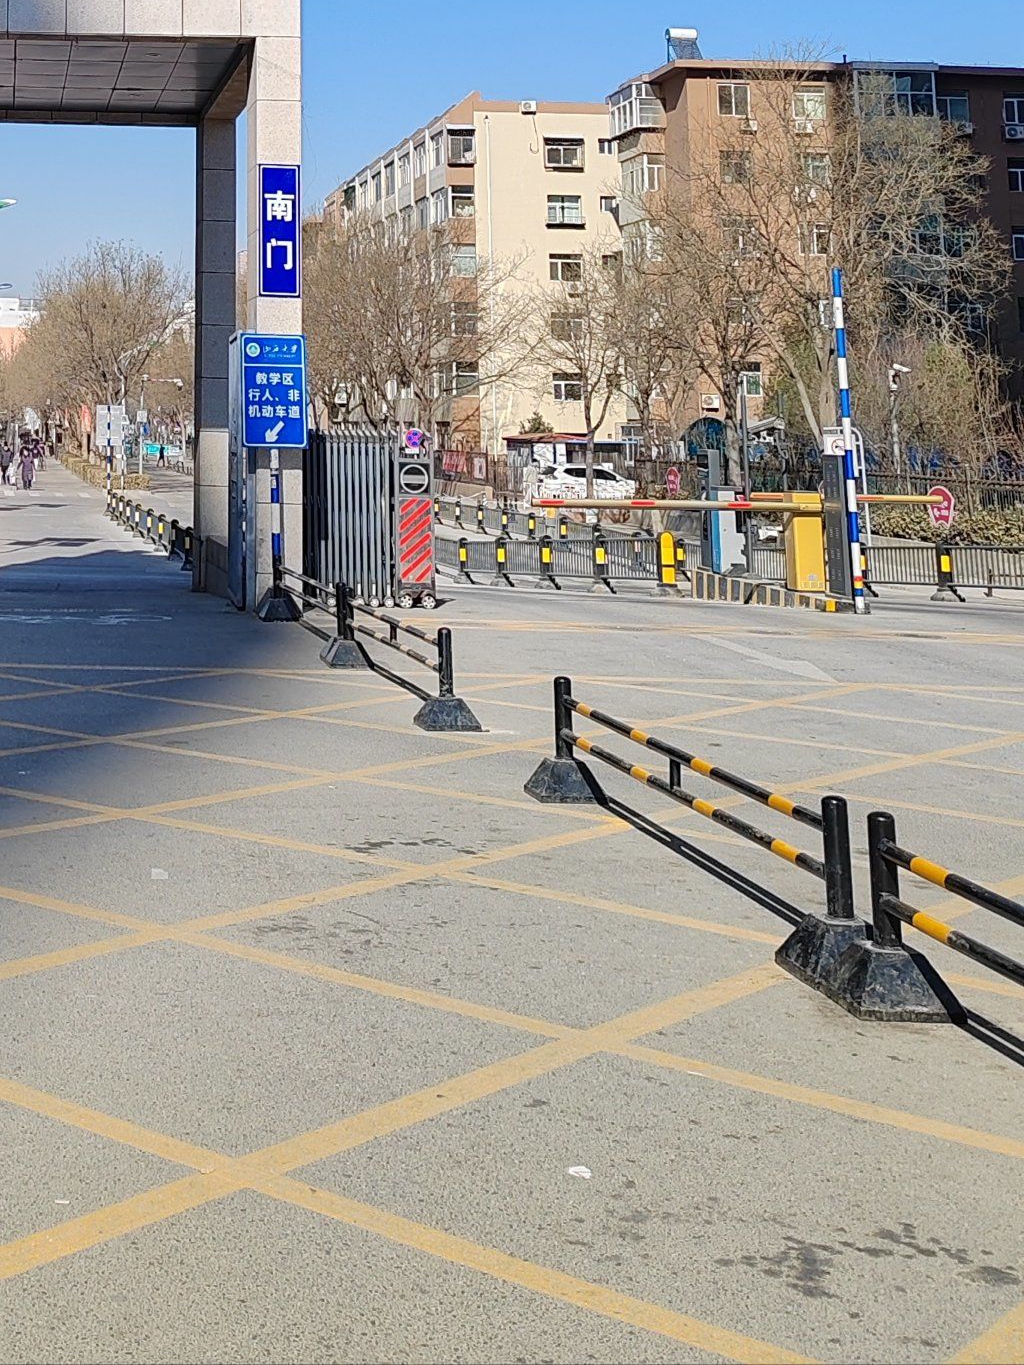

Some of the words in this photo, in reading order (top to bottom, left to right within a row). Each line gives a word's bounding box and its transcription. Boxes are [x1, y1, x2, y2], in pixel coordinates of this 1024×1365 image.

[264, 190, 295, 270] 南门
[256, 372, 294, 385] 教学区
[248, 404, 301, 419] 机动车道
